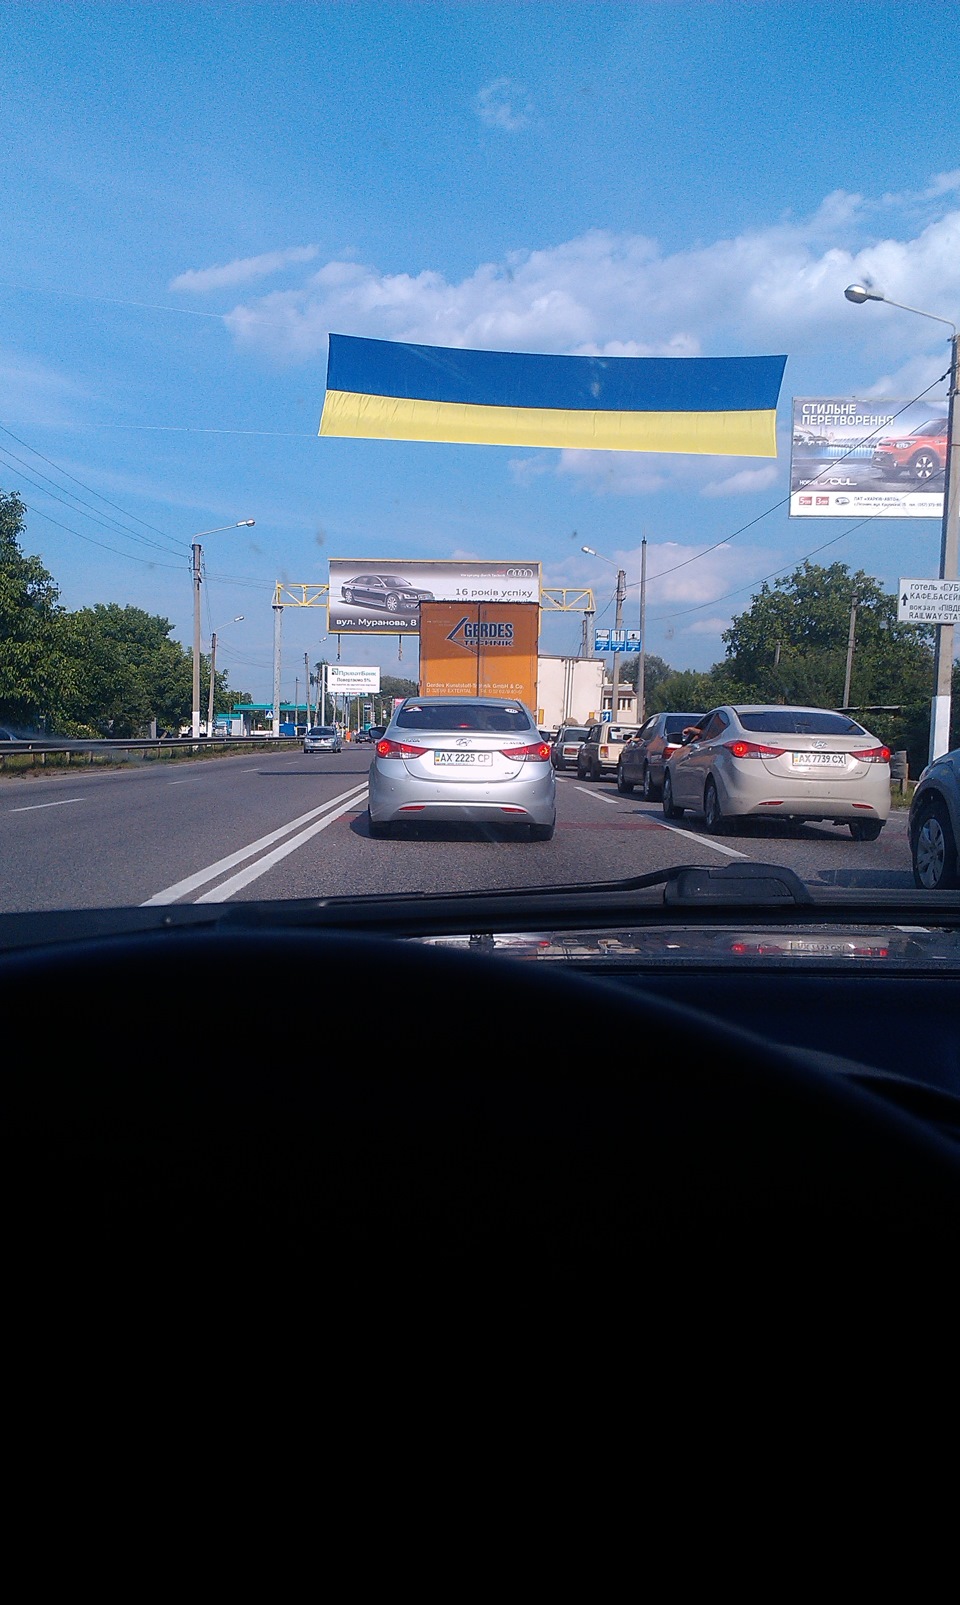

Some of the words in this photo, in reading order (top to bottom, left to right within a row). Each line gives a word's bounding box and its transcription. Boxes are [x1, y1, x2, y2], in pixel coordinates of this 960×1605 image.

[802, 403, 857, 415] СТИЛЬНЕ
[802, 415, 895, 427] ПЕРЕТВОРЕННЯ
[819, 477, 858, 486] SOUL
[910, 583, 938, 591] готель
[455, 588, 469, 596] 16
[471, 588, 499, 597] років
[501, 588, 533, 598] успіху
[909, 611, 942, 620] RAILWAY
[336, 619, 356, 627] вул.
[358, 618, 408, 627] Муранова,
[463, 622, 514, 639] GERDES
[463, 639, 514, 647] TECHNIK
[440, 752, 453, 763] AX
[455, 752, 476, 763] 2225
[478, 753, 490, 762] CP
[798, 754, 812, 764] AX
[812, 754, 831, 764] 7739
[831, 755, 845, 764] CX
